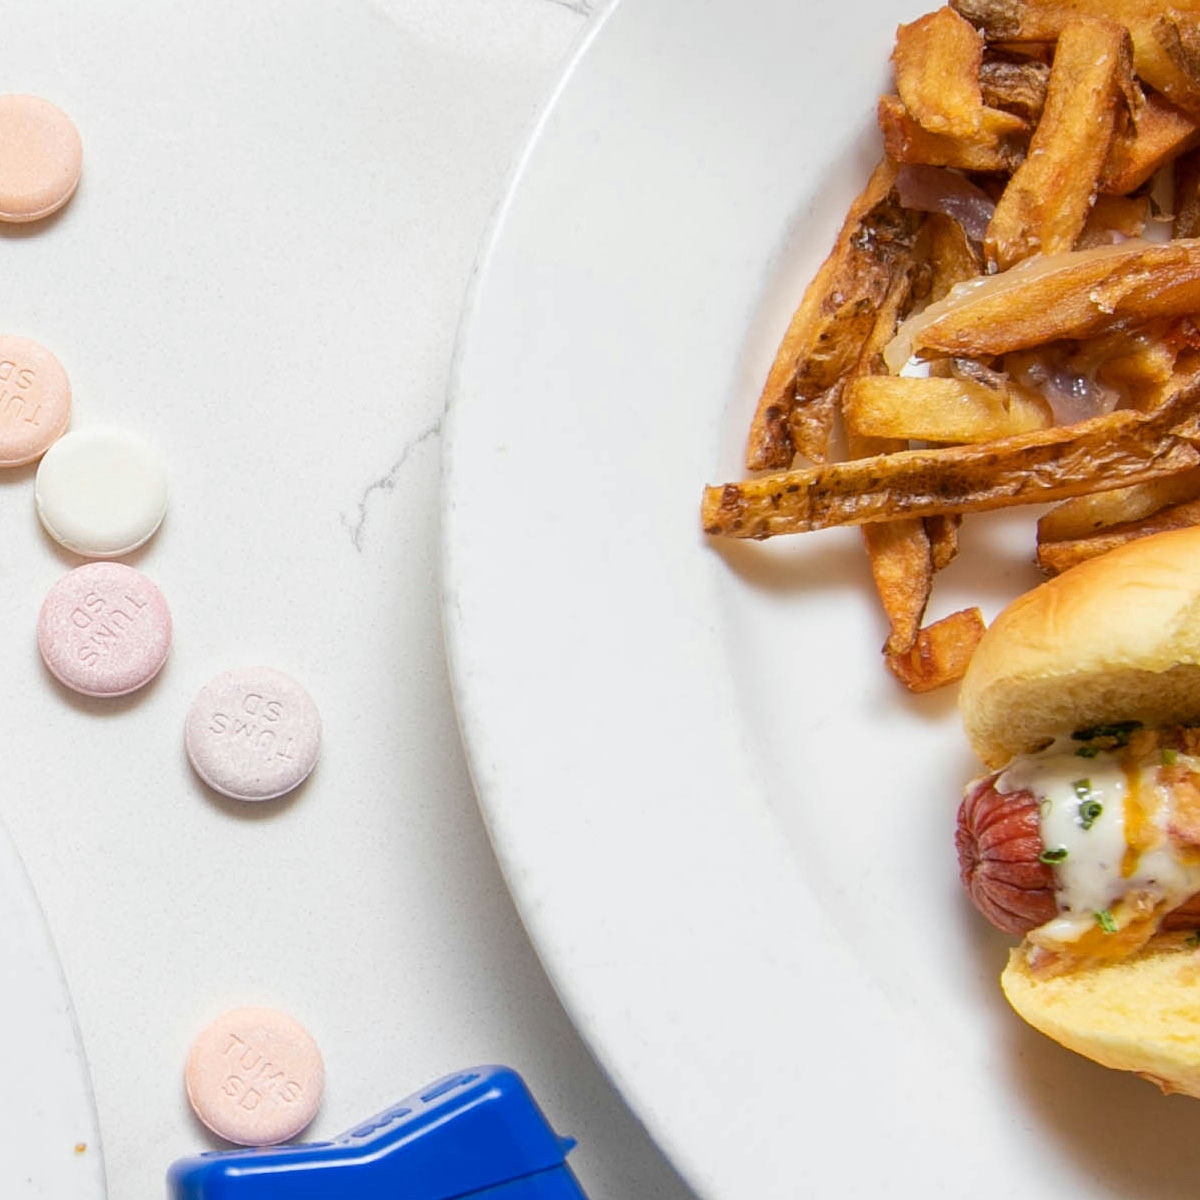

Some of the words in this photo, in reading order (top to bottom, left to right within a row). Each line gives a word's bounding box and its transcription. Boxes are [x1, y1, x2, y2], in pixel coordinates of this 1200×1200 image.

[71, 592, 105, 628] SD
[79, 595, 147, 667] TUMS
[243, 693, 283, 721] SD
[209, 713, 293, 759] TUMS
[223, 1033, 301, 1102] TUMS
[221, 1075, 262, 1110] SD
